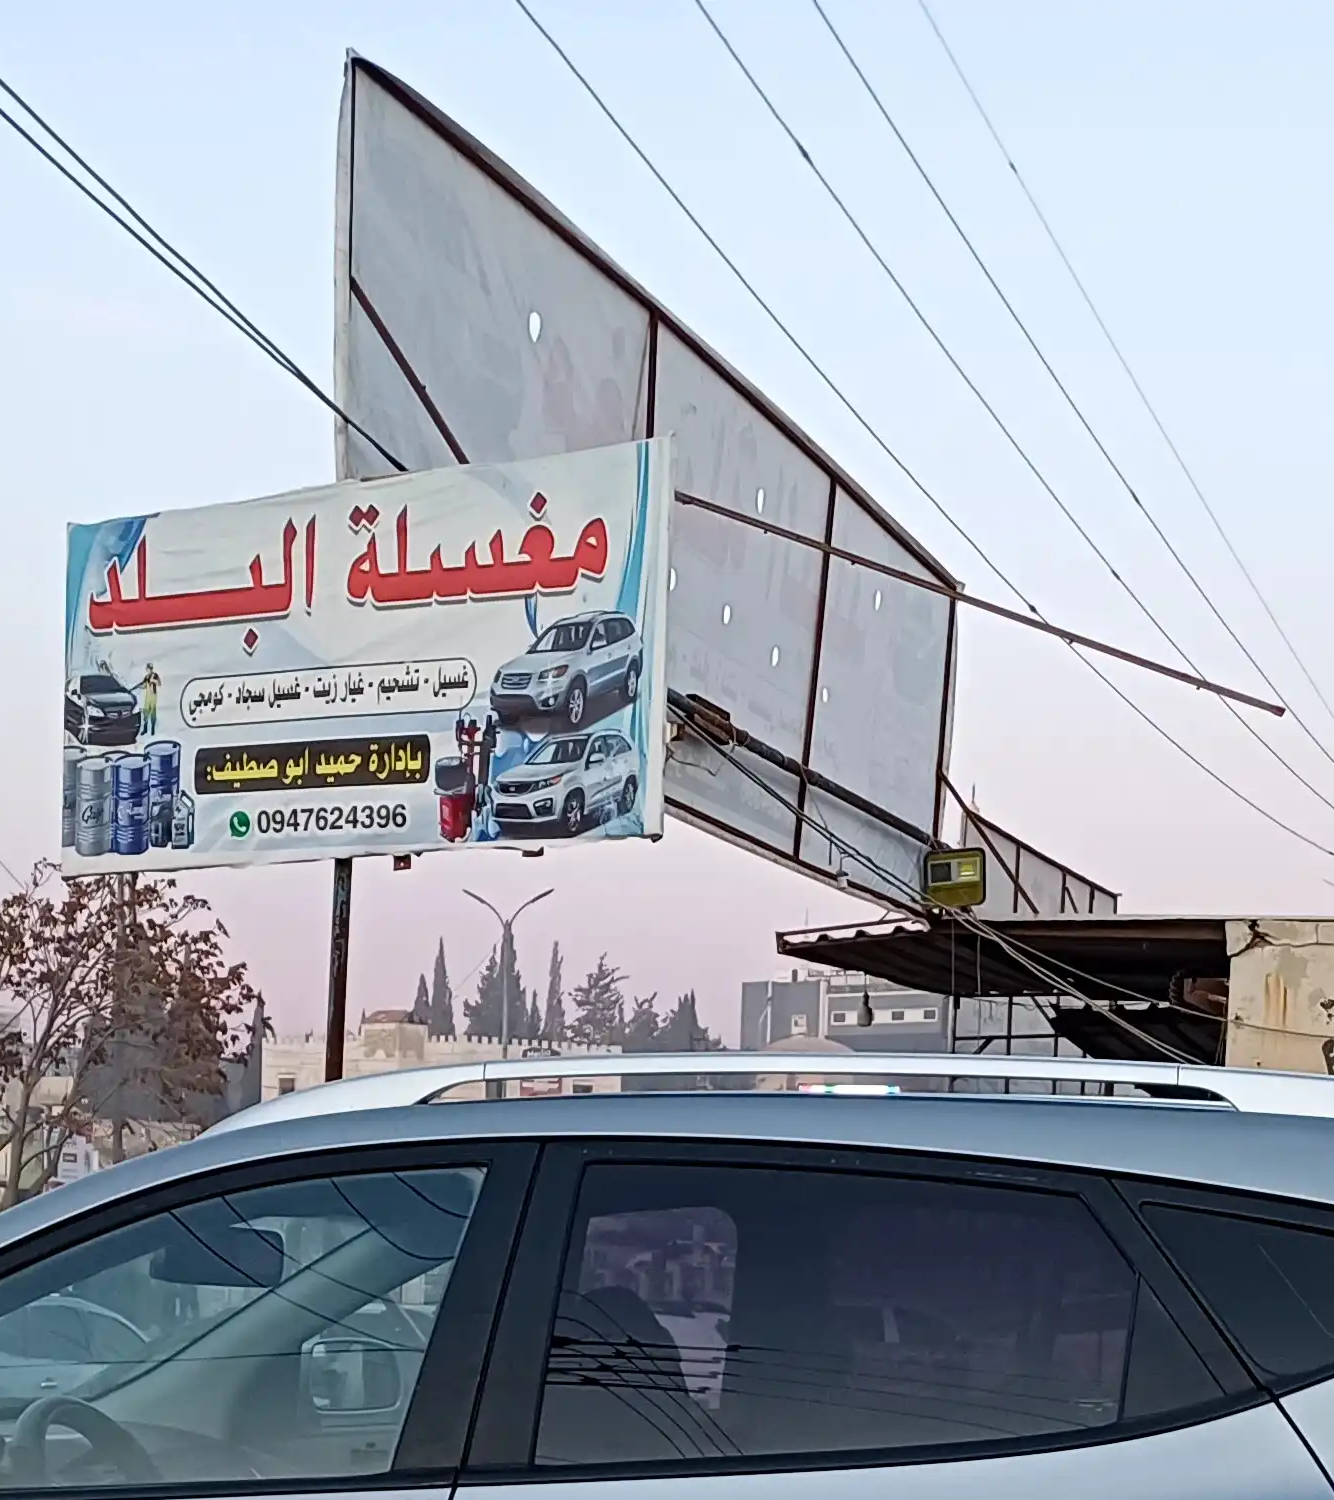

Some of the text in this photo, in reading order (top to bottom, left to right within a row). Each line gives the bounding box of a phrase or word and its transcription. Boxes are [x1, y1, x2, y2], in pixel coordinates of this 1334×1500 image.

[86, 492, 610, 653] مغسلة البلد
[235, 681, 265, 711] سجاد
[268, 676, 301, 709] غسيل
[313, 673, 337, 704] زيت
[340, 671, 364, 703] غيار
[377, 665, 420, 704] تشحيم
[432, 664, 469, 698] غسيل
[281, 747, 310, 786] ابو
[315, 751, 363, 783] حميد
[368, 742, 423, 780] بإدارة
[256, 804, 408, 834] 0947624396
